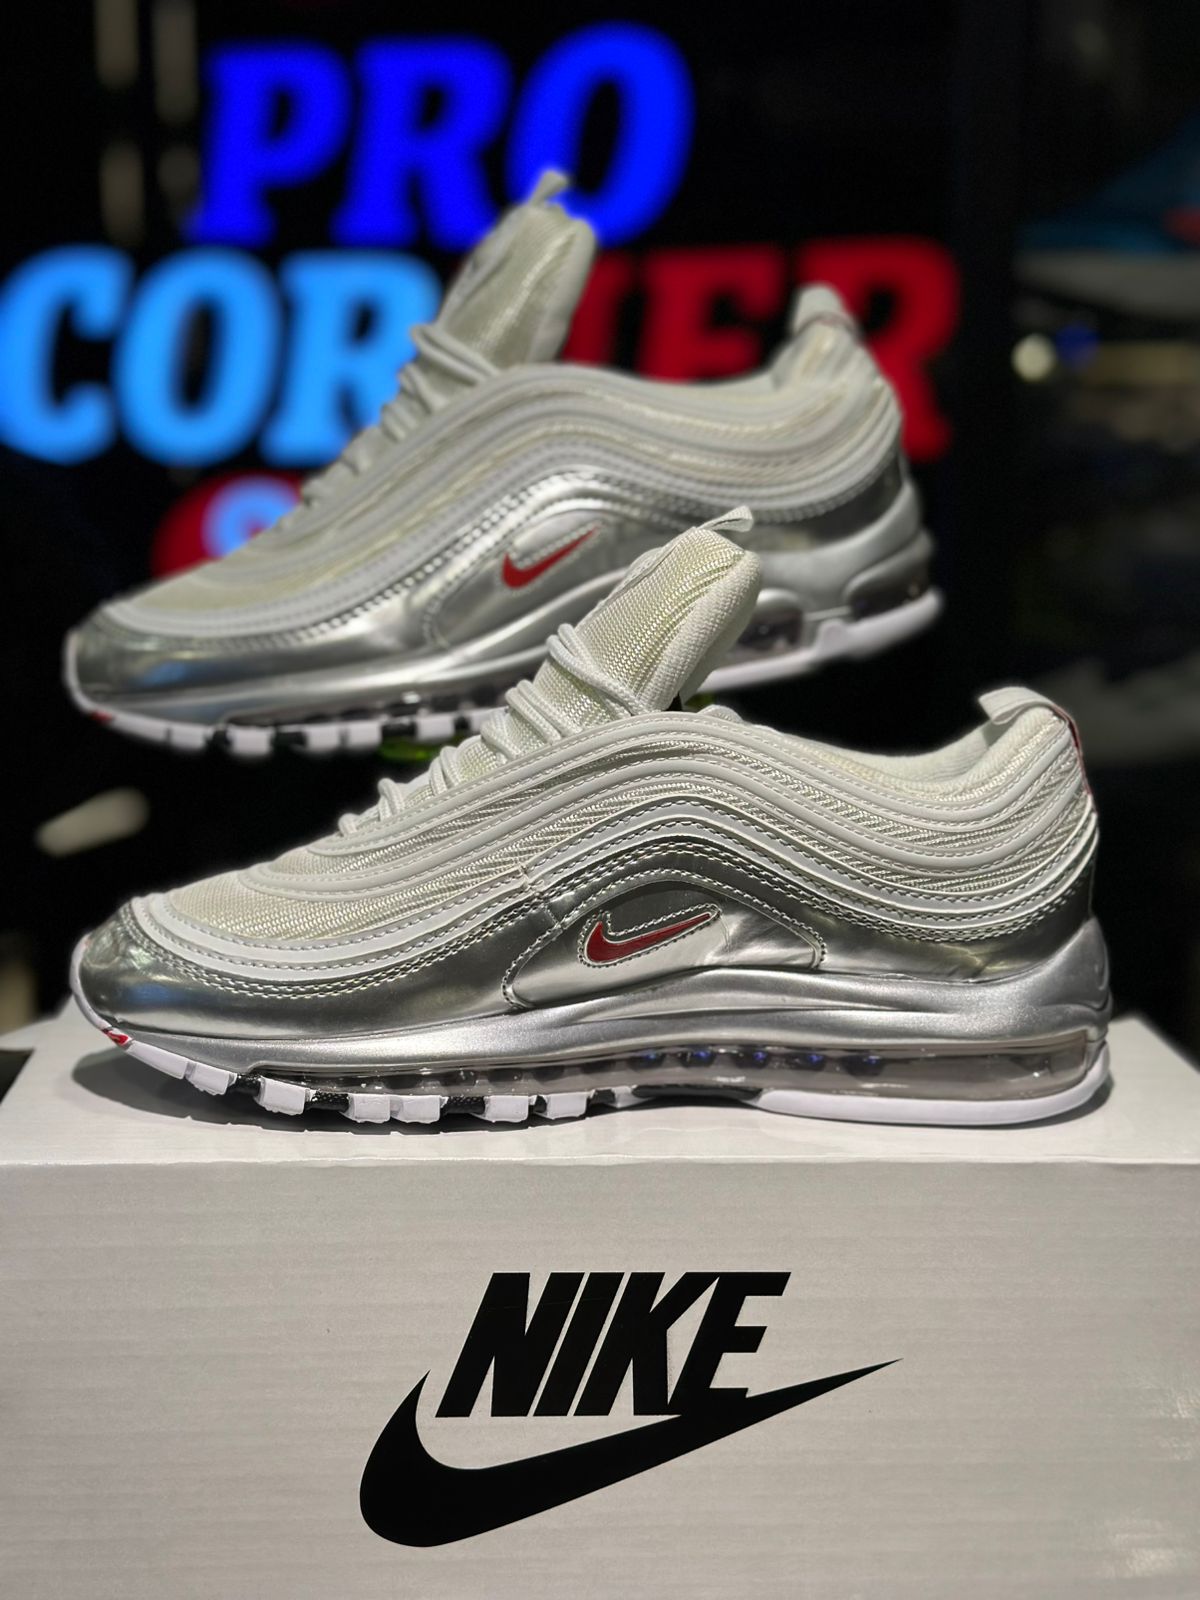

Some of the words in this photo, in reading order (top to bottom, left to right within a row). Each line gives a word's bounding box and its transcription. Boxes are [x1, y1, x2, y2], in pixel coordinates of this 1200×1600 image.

[189, 24, 693, 247] PRO
[0, 243, 956, 463] CORER
[435, 1271, 792, 1418] NIKE
